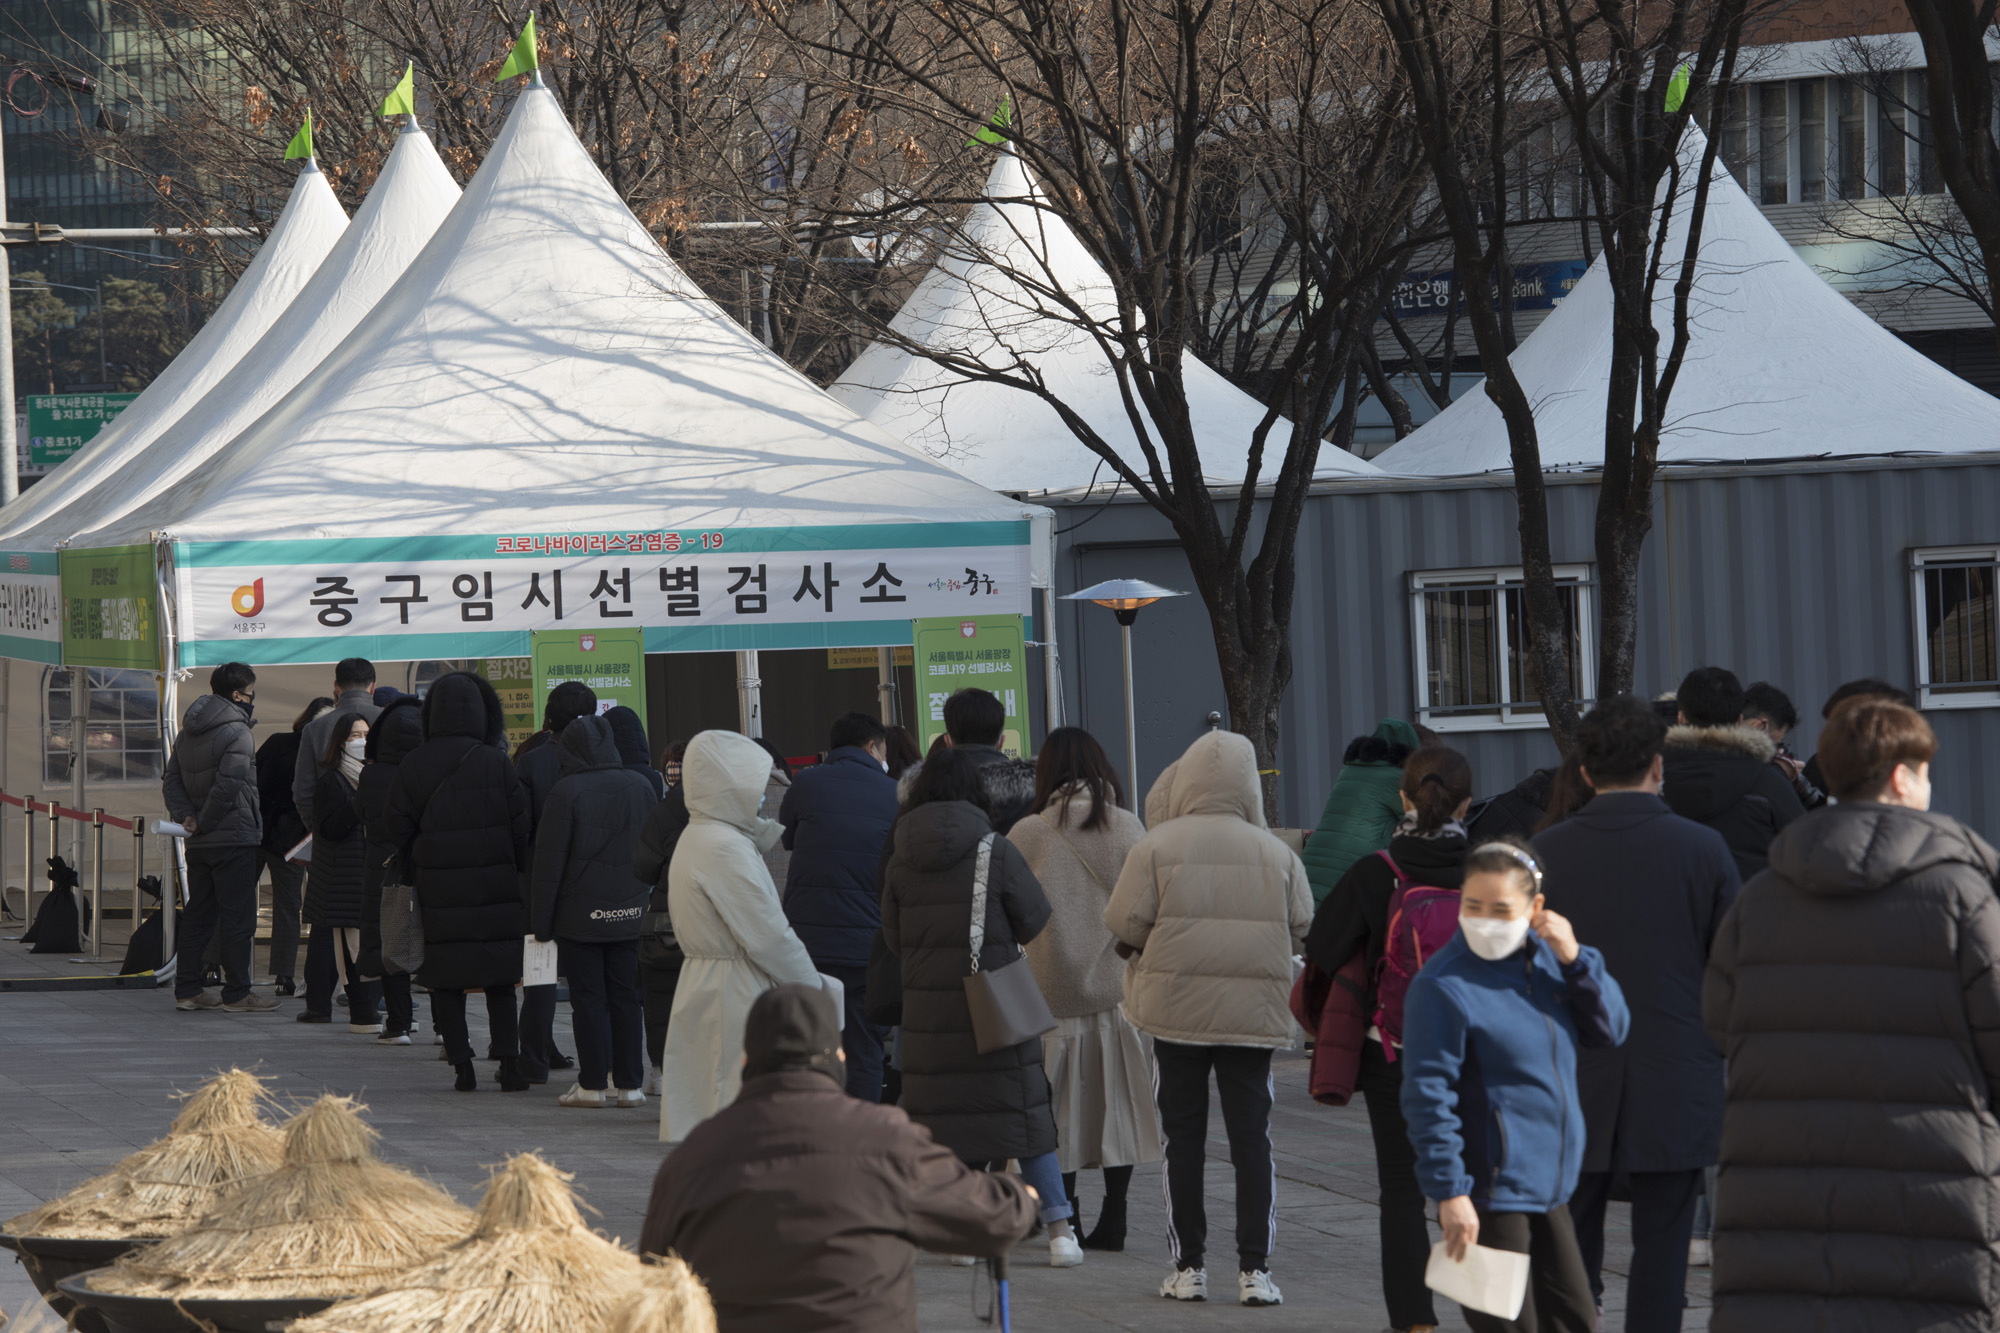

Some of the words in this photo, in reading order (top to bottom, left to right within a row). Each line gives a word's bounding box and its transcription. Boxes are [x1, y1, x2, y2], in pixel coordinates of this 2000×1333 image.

[1383, 280, 1449, 309] 한은행
[1511, 277, 1543, 298] Bank
[51, 409, 104, 421] 을지로2가
[45, 435, 82, 448] 종로1가
[495, 532, 682, 555] 코로나바이러스감염증
[699, 532, 723, 550] 19
[962, 567, 995, 596] 중구
[0, 584, 49, 631] 구임시선별검사소
[233, 622, 266, 633] 서울중구
[929, 649, 973, 663] 서울특별시
[975, 648, 1011, 660] 서울광장
[547, 664, 592, 676] 서울특별시
[594, 663, 631, 675] 서울광장
[928, 663, 966, 676] 코로나19
[967, 661, 1013, 674] 선별검사소
[586, 675, 632, 689] 선별검사소
[928, 688, 1017, 721] 절내
[590, 906, 643, 919] Discovery
